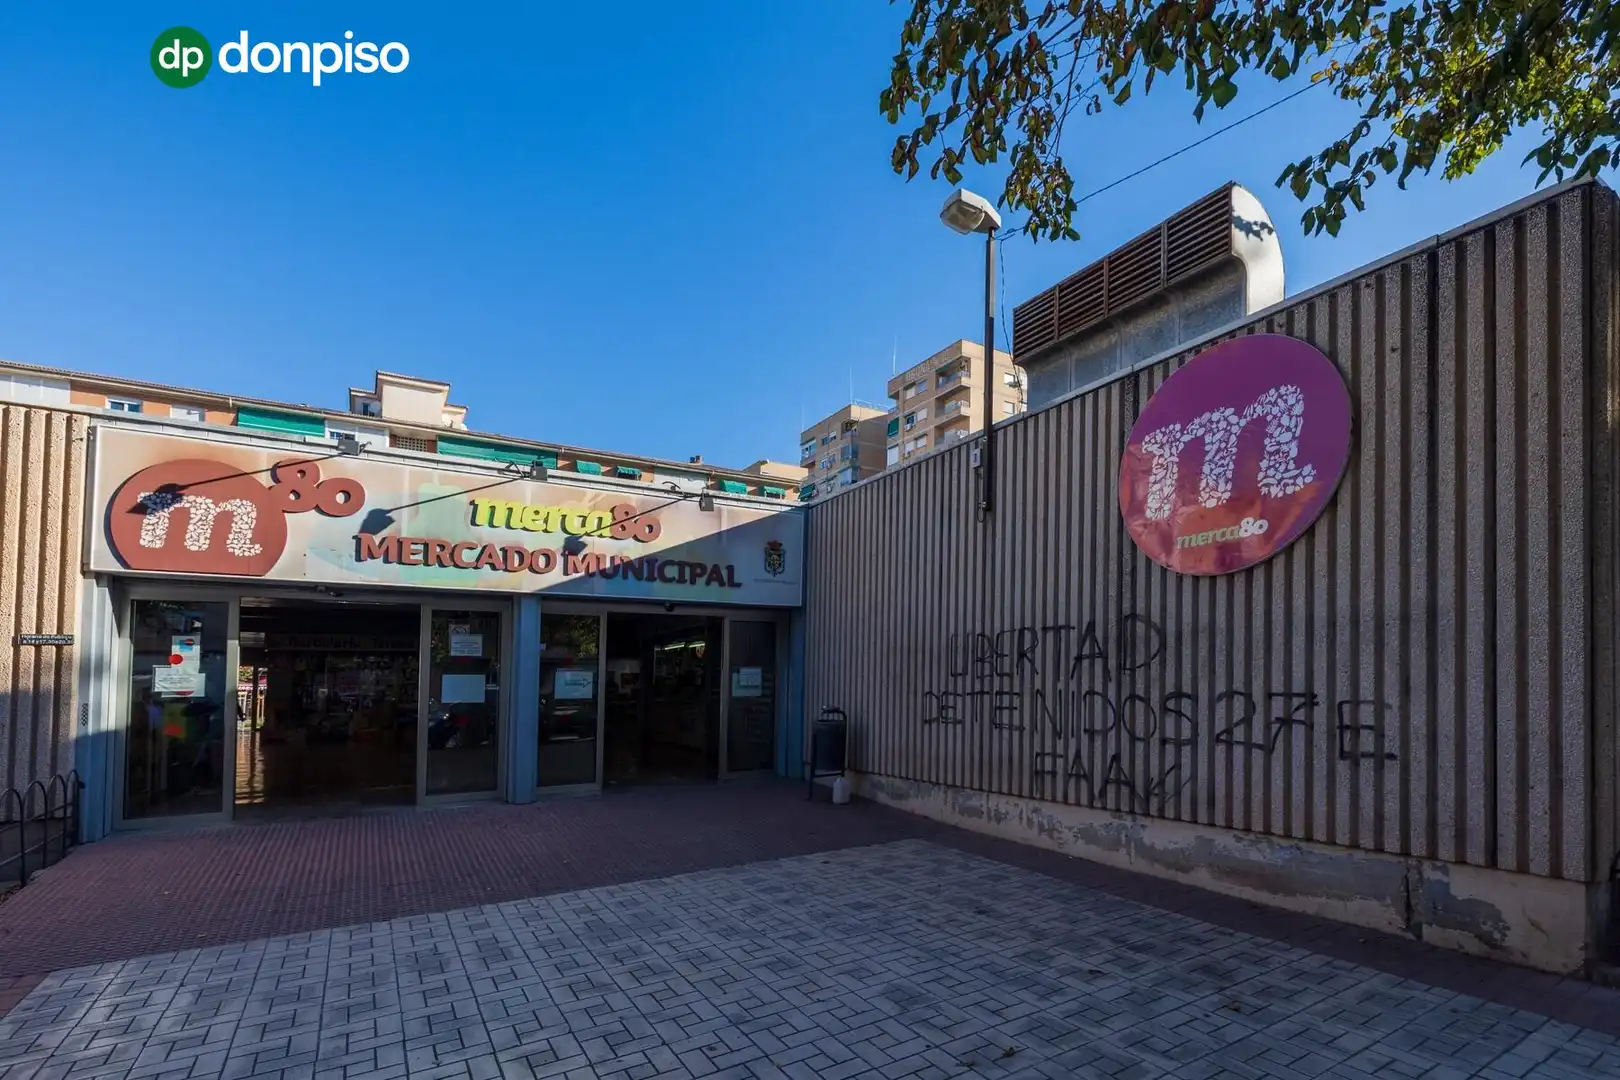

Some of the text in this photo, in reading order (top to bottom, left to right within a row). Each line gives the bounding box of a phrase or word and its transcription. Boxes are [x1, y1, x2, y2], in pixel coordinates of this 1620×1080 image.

[354, 532, 743, 589] MERCADO MUNICIPAL
[923, 688, 1200, 746] DETENIDOS
[1215, 691, 1320, 755] 27
